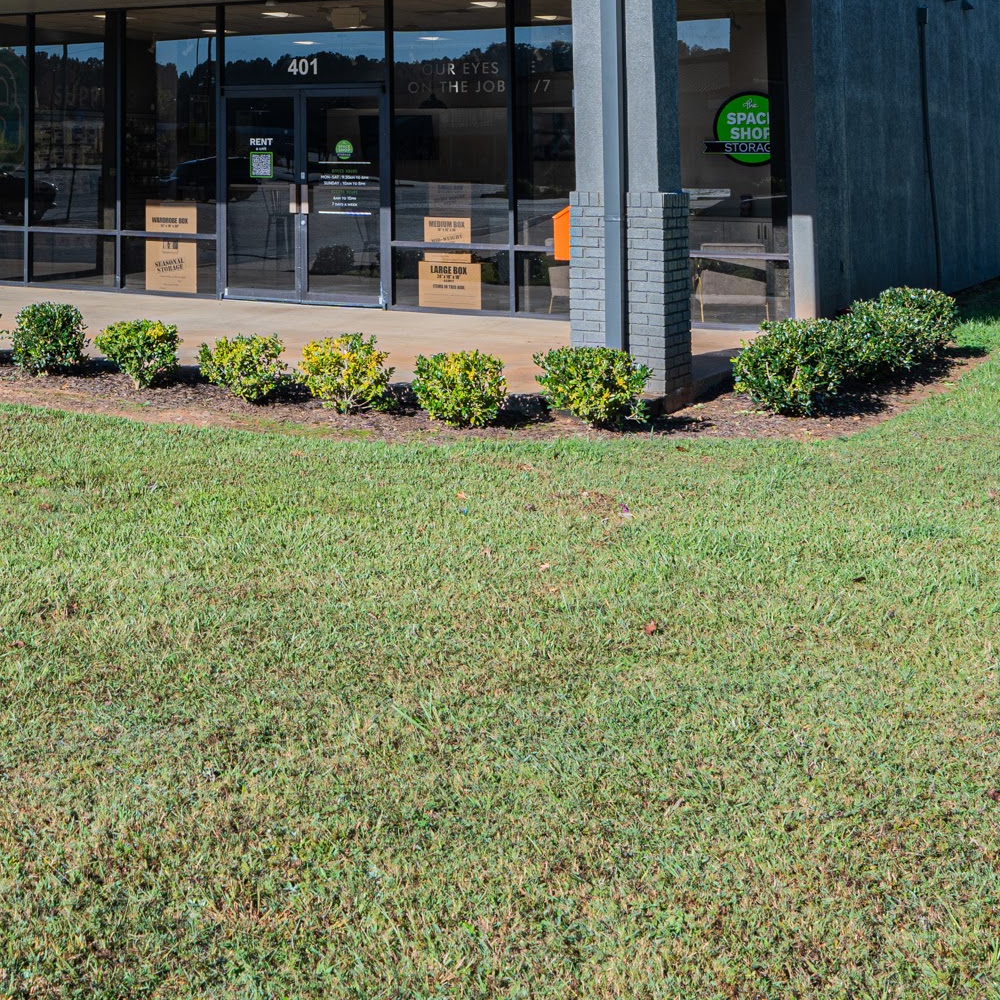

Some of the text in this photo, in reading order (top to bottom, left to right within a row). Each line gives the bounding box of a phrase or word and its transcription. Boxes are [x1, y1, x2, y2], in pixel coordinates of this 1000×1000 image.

[287, 58, 318, 76] 401
[421, 62, 499, 77] OUR EYES
[408, 81, 433, 95] ON
[440, 80, 468, 93] THE
[475, 79, 506, 93] JOB
[727, 112, 770, 125] SPAC
[249, 137, 273, 146] RENT
[724, 142, 770, 153] STORAG
[151, 216, 189, 225] WARDROBE BOX
[428, 220, 465, 229] MEDIUM BOX
[154, 257, 185, 268] SEASONAL
[156, 264, 184, 274] STORAGE
[430, 265, 467, 275] LARGE BOX
